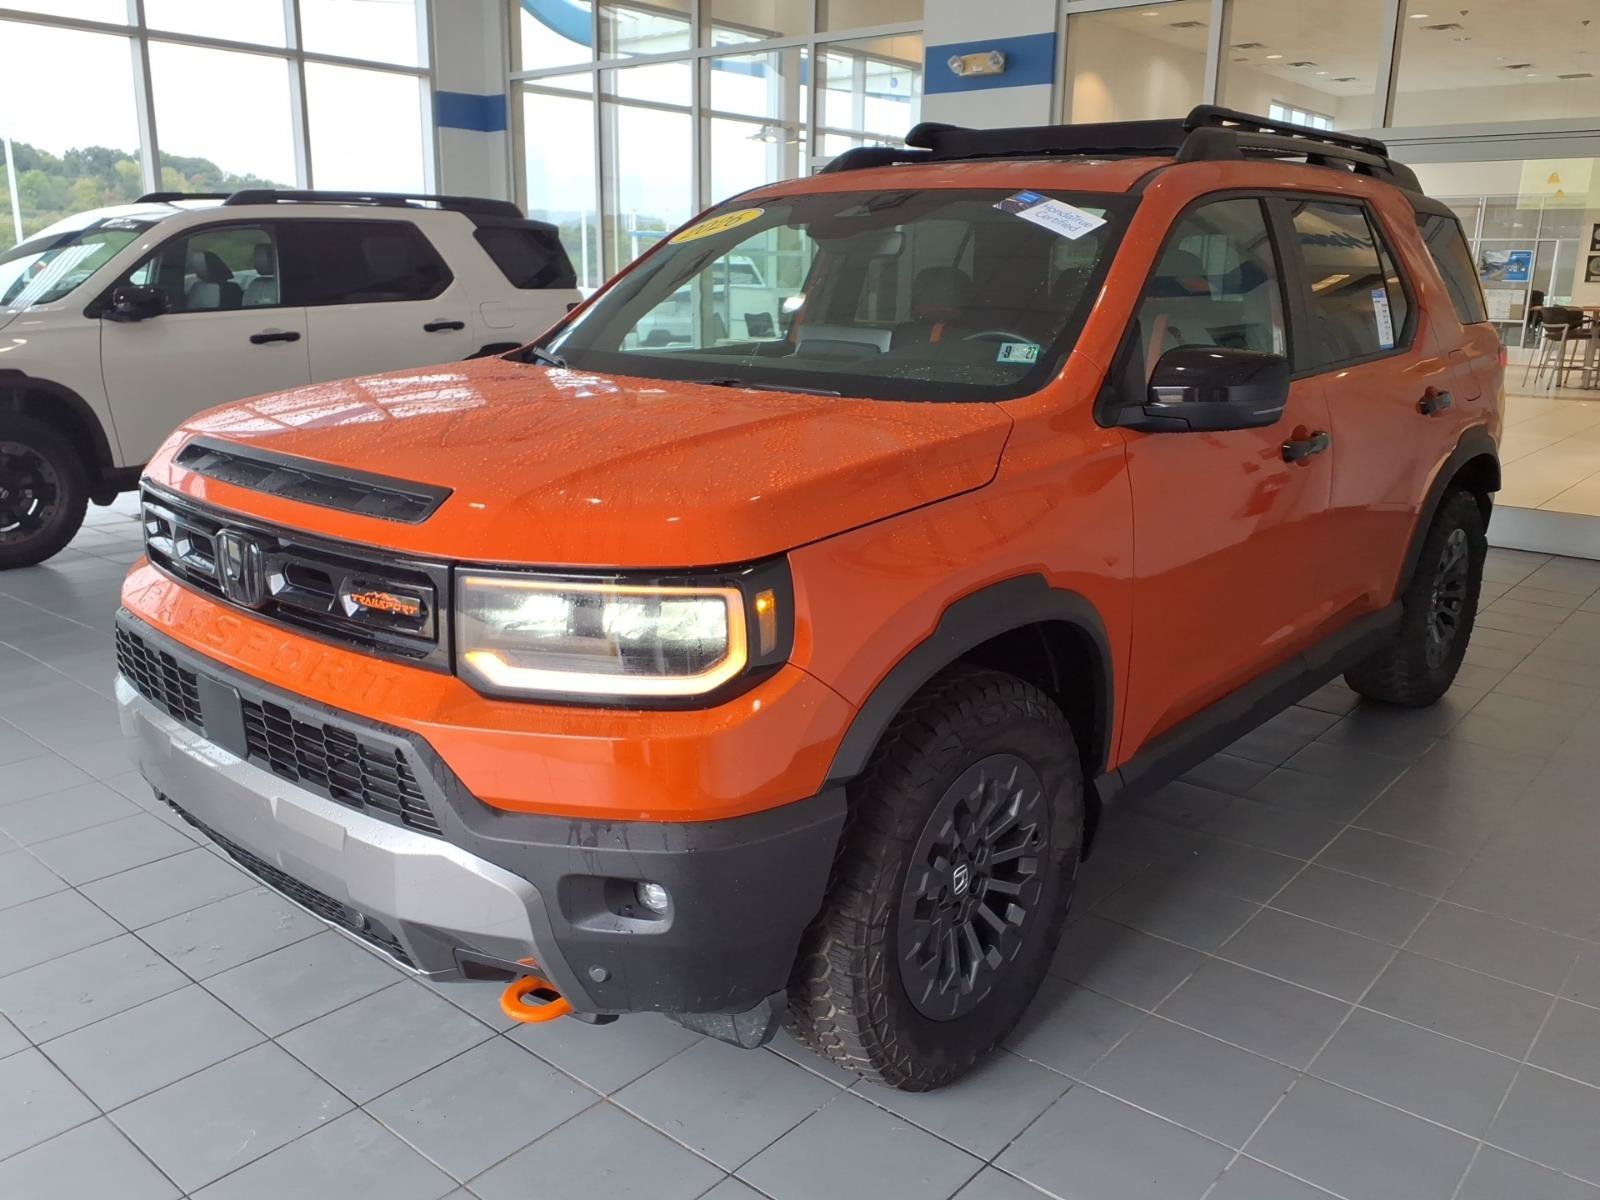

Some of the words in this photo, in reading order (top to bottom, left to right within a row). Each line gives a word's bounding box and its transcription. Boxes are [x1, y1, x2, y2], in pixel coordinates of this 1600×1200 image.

[1034, 210, 1082, 233] Certified
[1041, 202, 1093, 229] HondaTrue
[1003, 345, 1013, 359] 9
[350, 592, 418, 615] TRAILSPORT
